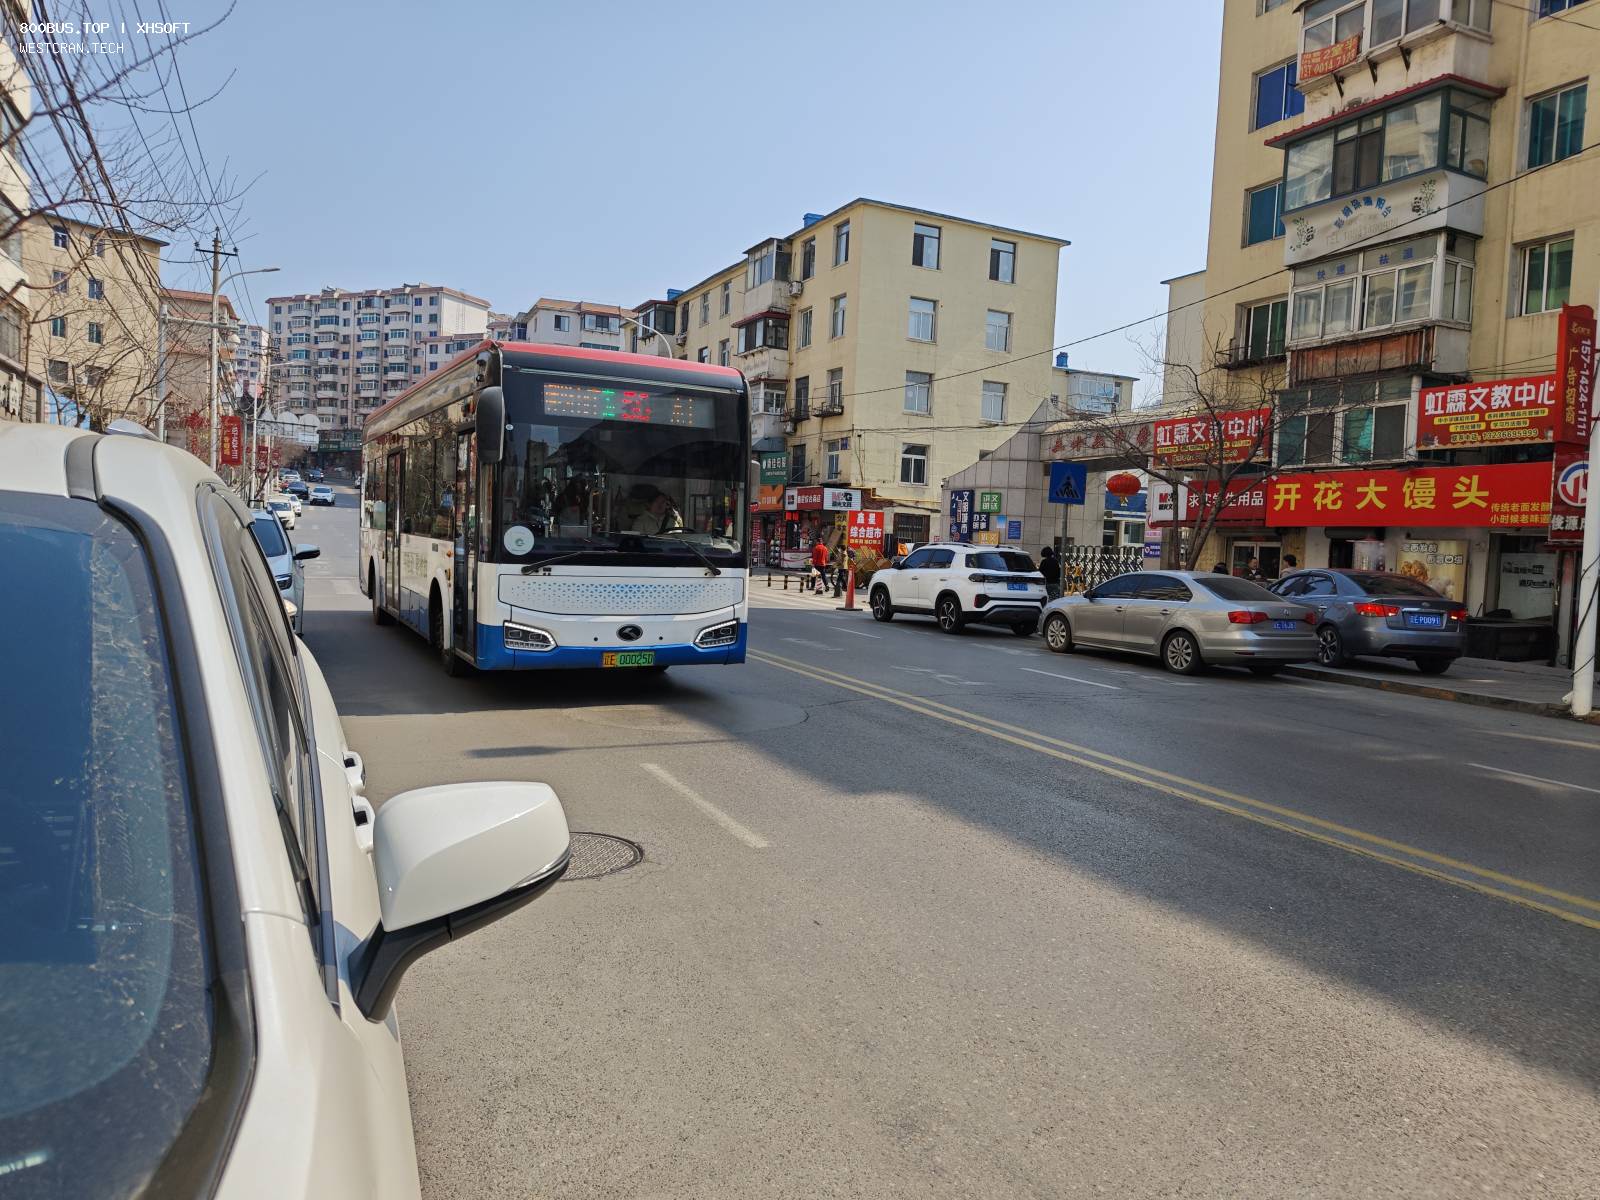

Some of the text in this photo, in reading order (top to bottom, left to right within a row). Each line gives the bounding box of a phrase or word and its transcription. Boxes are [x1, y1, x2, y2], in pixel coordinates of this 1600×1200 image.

[1425, 380, 1556, 416] 虹霖文教中心
[1273, 475, 1489, 511] 开花大馒头
[850, 526, 882, 538] 综合超市
